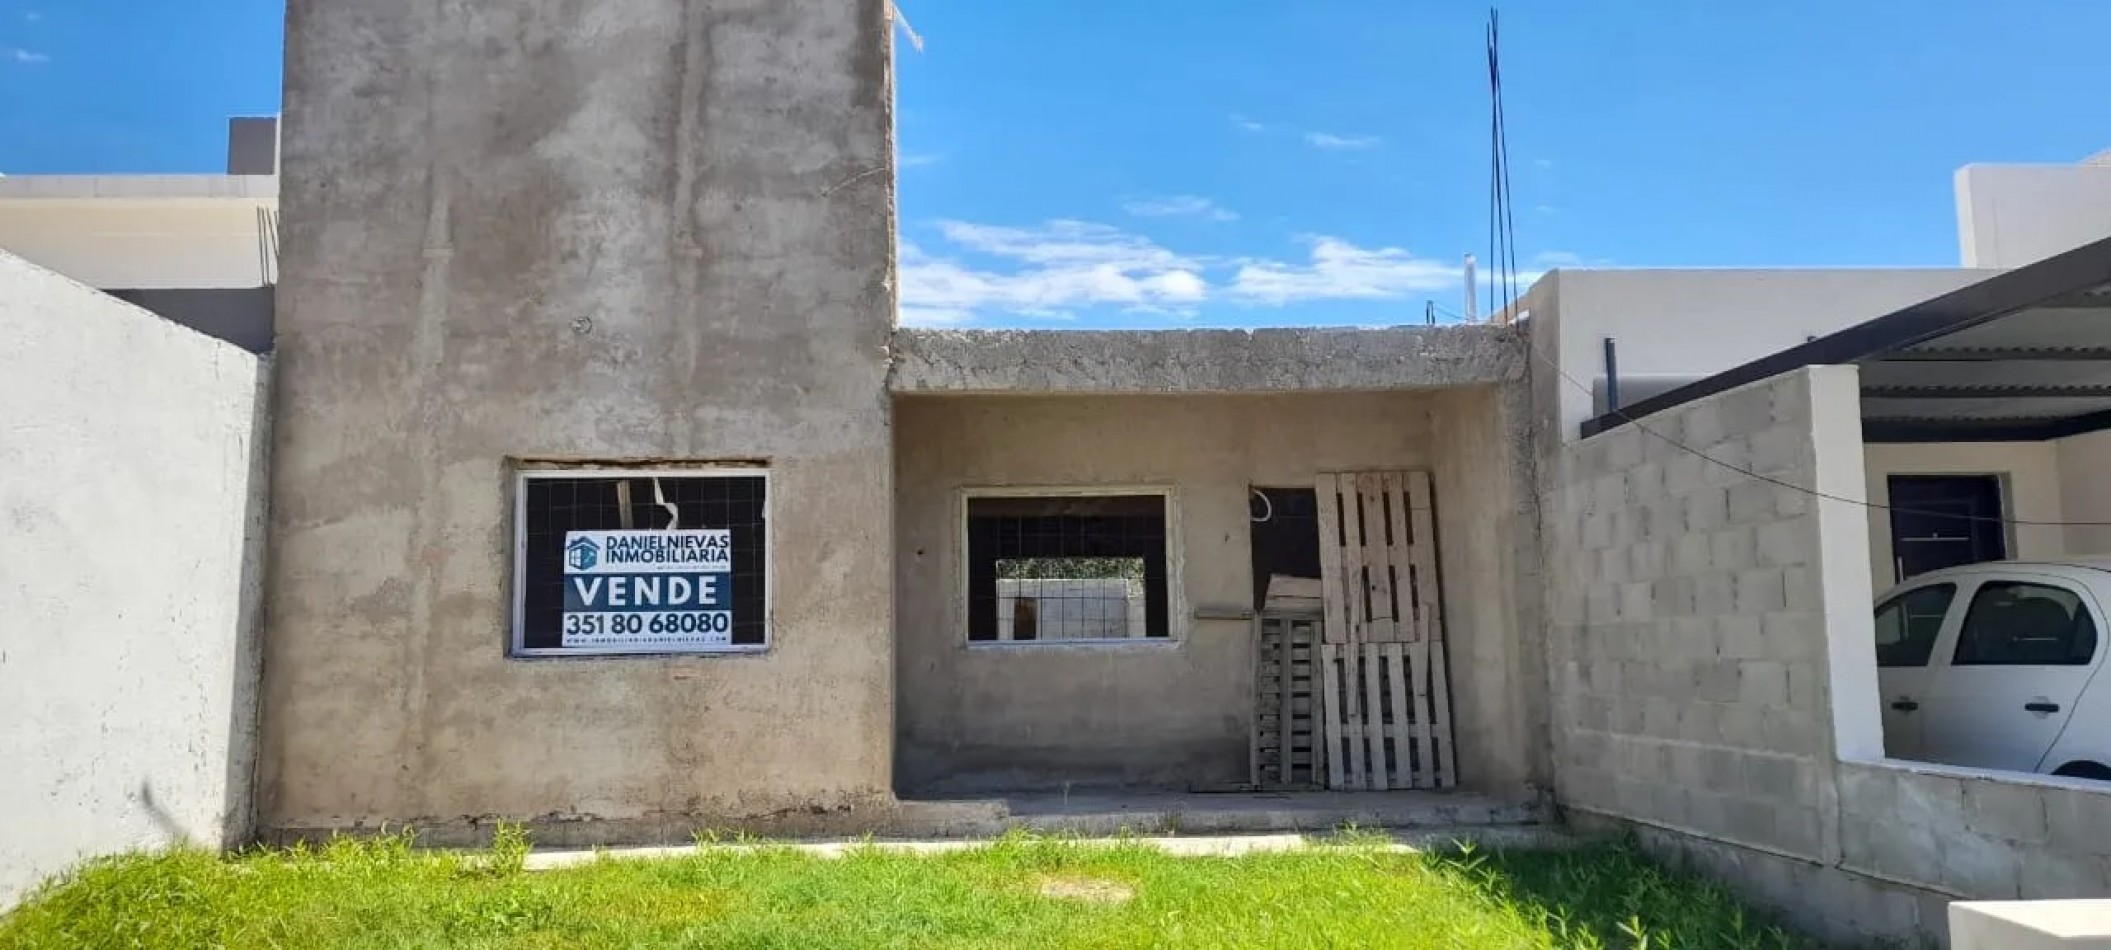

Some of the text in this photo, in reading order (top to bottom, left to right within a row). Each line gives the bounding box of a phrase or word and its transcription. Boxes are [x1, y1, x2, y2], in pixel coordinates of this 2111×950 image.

[606, 549, 728, 563] INMOBILIARIA
[574, 576, 717, 606] VENDE
[566, 613, 728, 635] 351 80 68080
